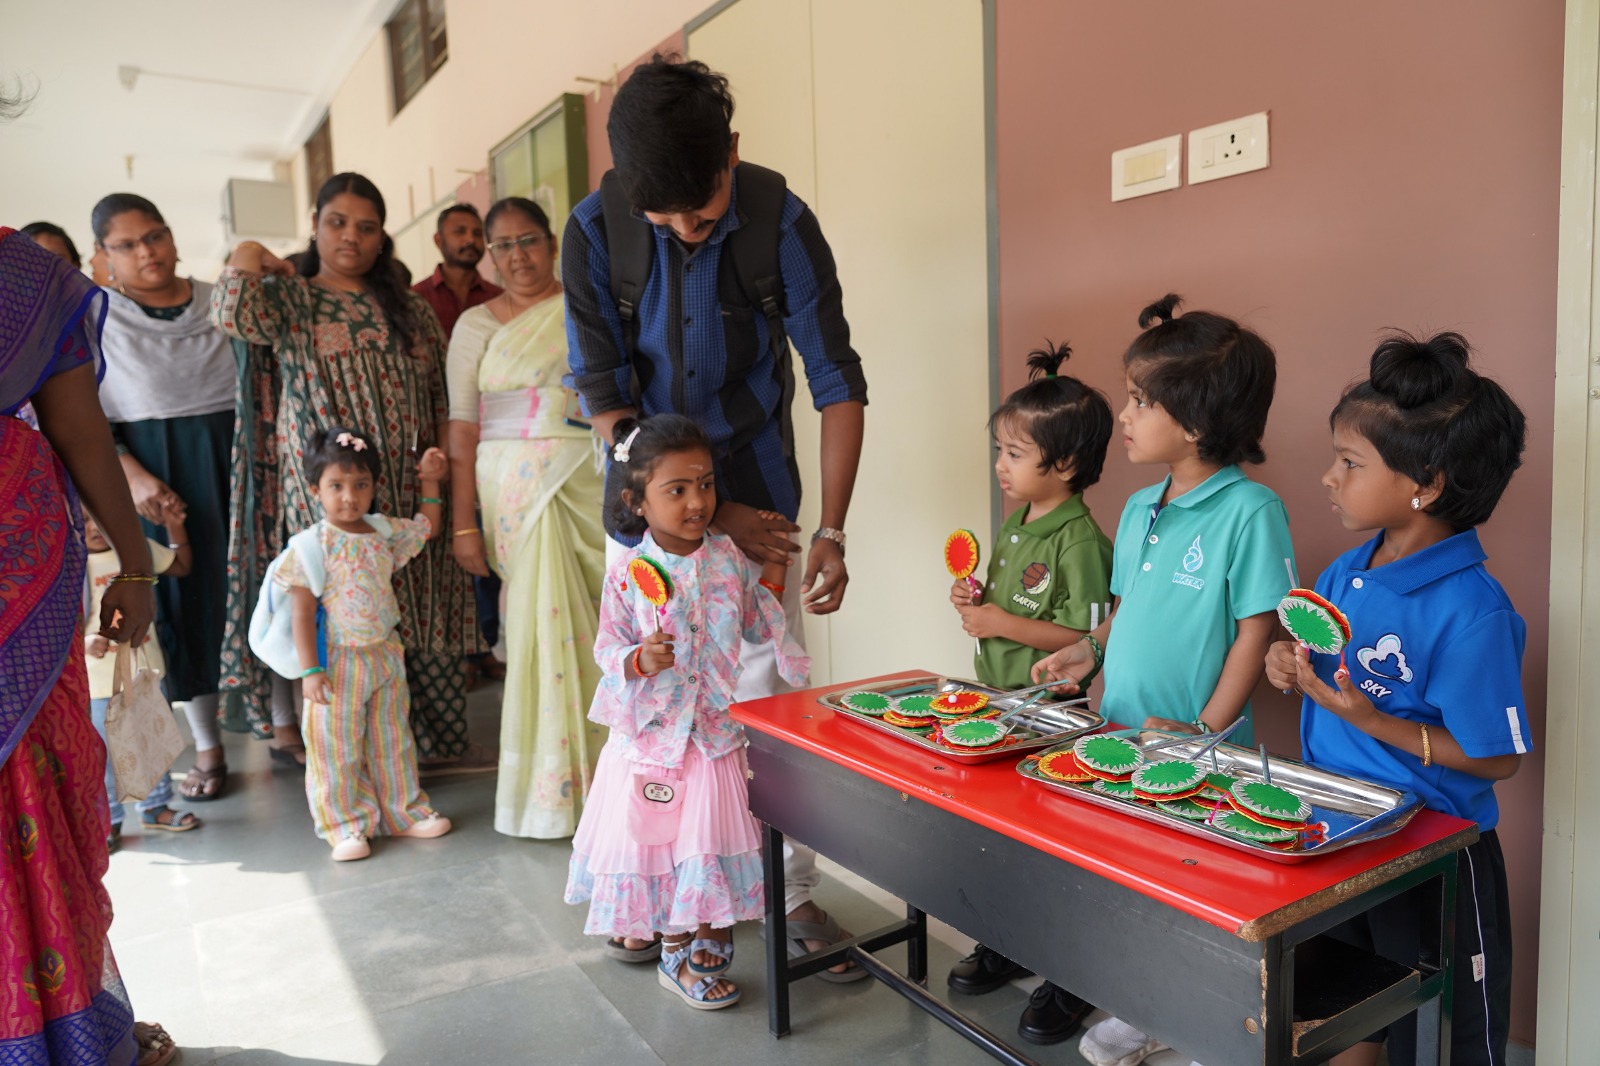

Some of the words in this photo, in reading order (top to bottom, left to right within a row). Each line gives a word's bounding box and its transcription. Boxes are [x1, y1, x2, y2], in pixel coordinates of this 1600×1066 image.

[1172, 572, 1205, 590] WATER
[1012, 593, 1040, 611] EARTH
[1360, 679, 1392, 698] SKY
